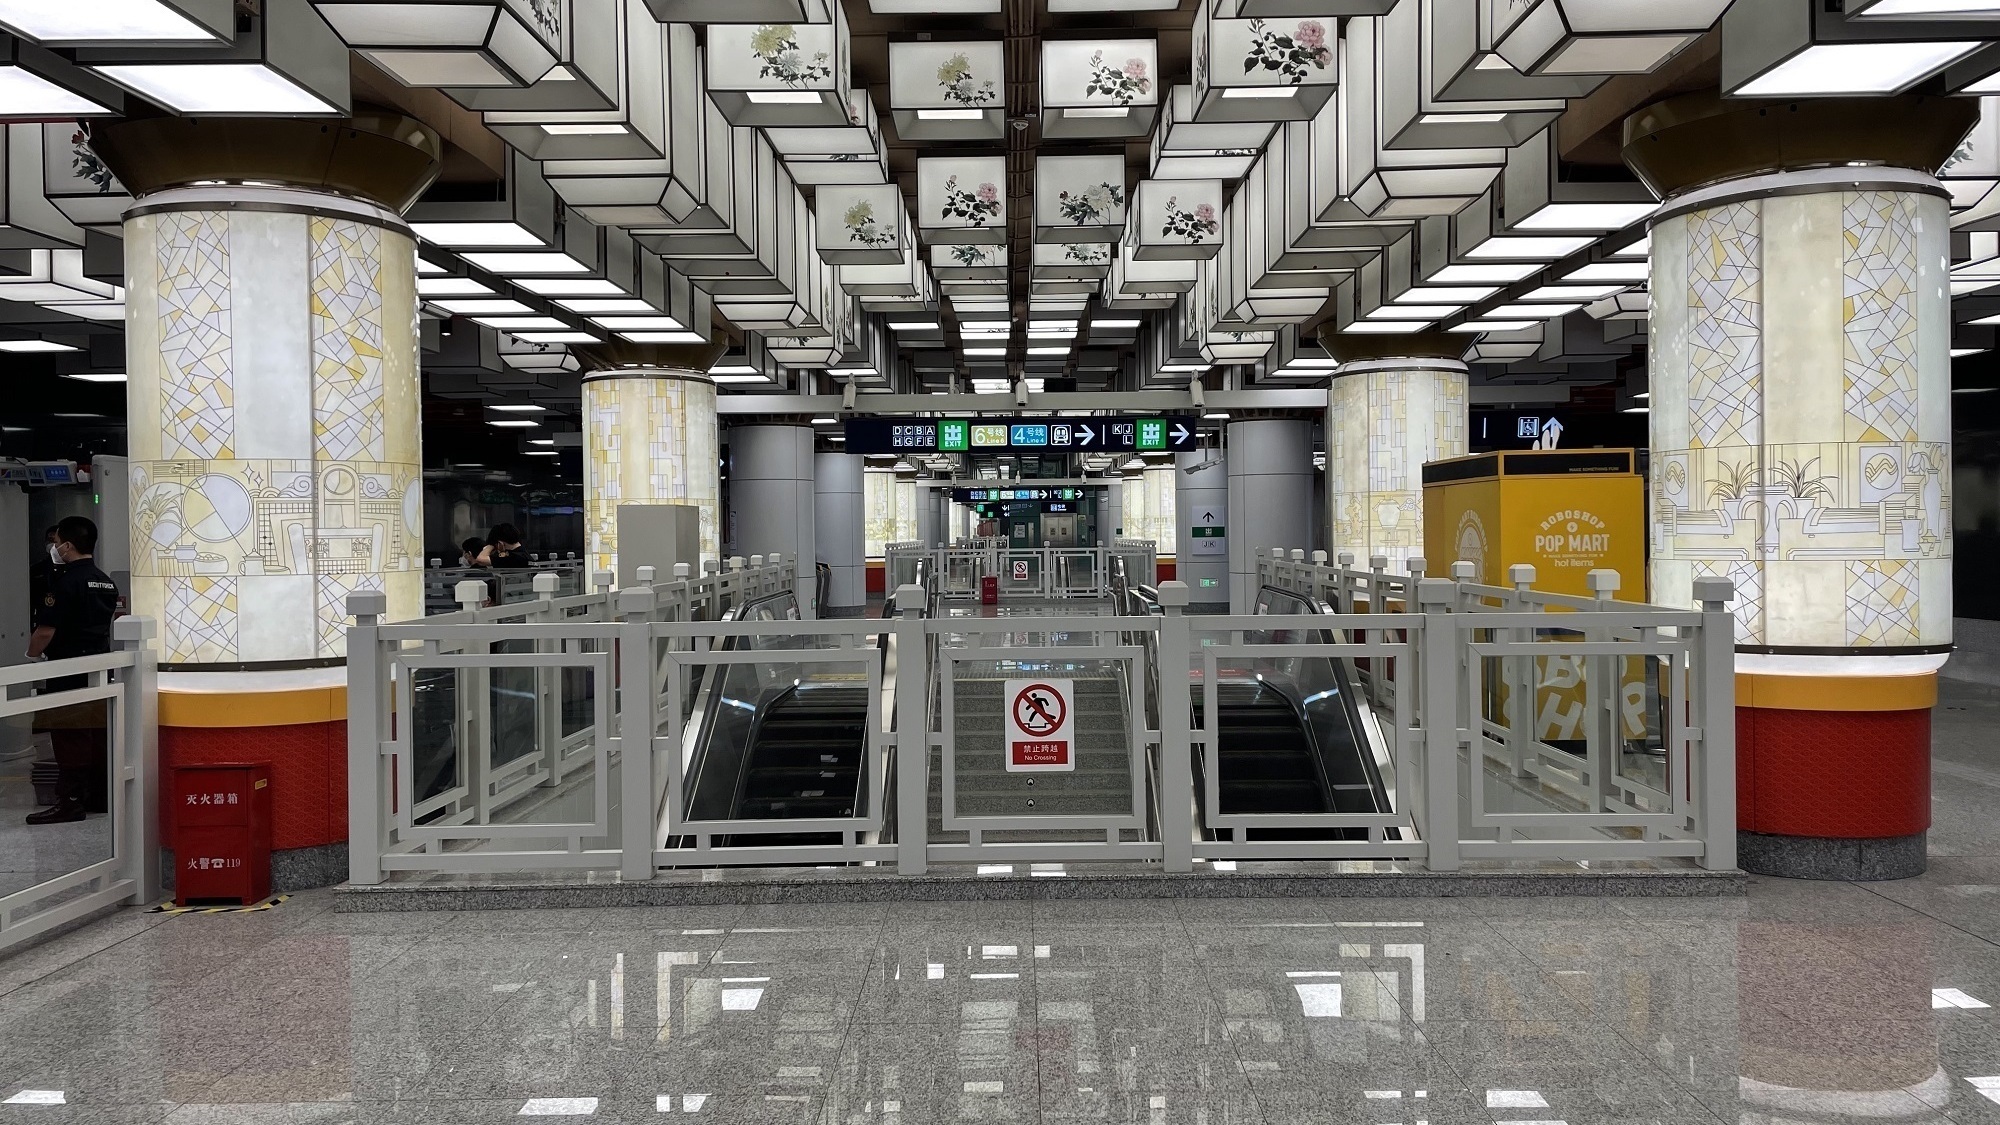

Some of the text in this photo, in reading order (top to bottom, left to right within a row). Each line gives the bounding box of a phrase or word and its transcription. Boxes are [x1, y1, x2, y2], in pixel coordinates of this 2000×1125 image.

[1540, 510, 1605, 531] ROBOSHOP
[1535, 534, 1610, 552] POP MART
[1554, 559, 1594, 567] hot items
[1024, 745, 1058, 753] 禁止跨越
[185, 792, 238, 806] 灭火器箱
[187, 857, 241, 870] 火警 119
